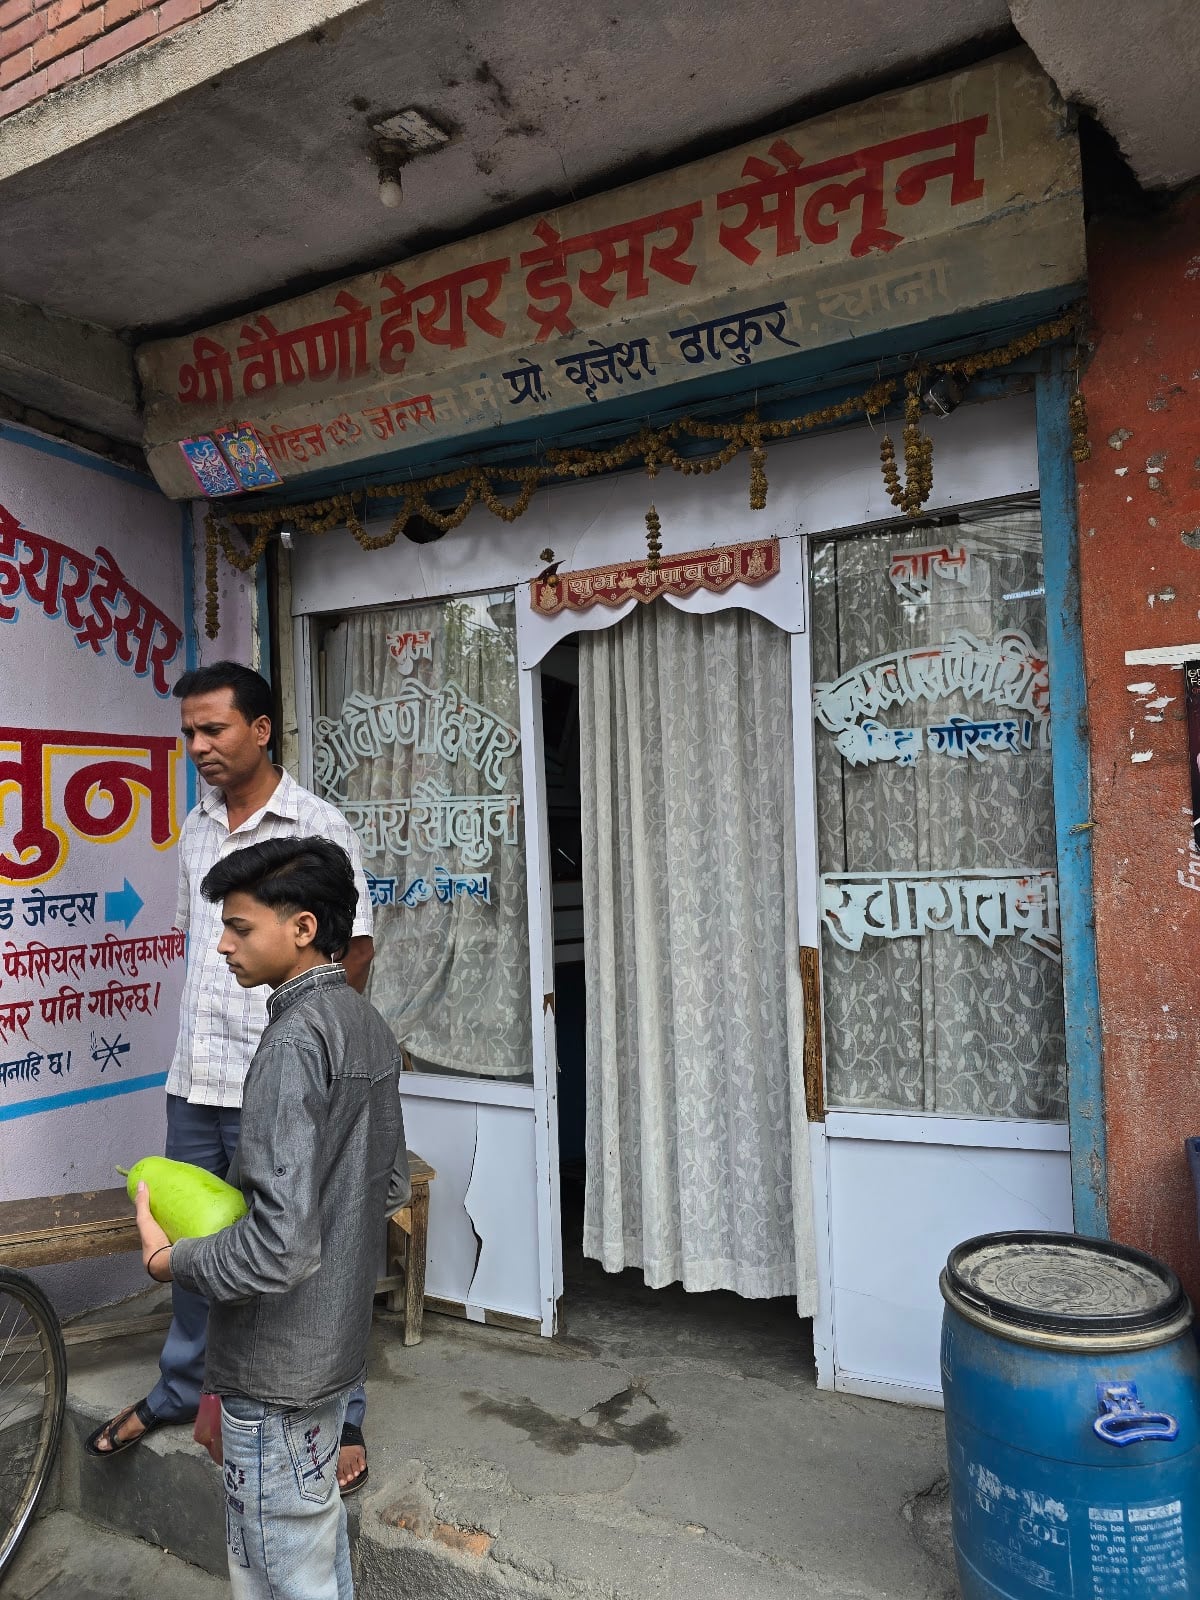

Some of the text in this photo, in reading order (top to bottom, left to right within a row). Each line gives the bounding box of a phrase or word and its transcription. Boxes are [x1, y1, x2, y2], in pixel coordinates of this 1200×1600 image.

[379, 272, 511, 374] हेयर
[519, 201, 703, 344] ड्रेसर
[716, 114, 989, 266] सैलून
[669, 301, 801, 365] ठाकुर
[568, 572, 619, 598] शुभ
[22, 888, 98, 927] जेन्ट्स
[2, 940, 88, 988] फेसियल
[39, 985, 84, 1026] पनि
[88, 979, 161, 1021] गरिन्छ।
[1107, 1545, 1126, 1555] give
